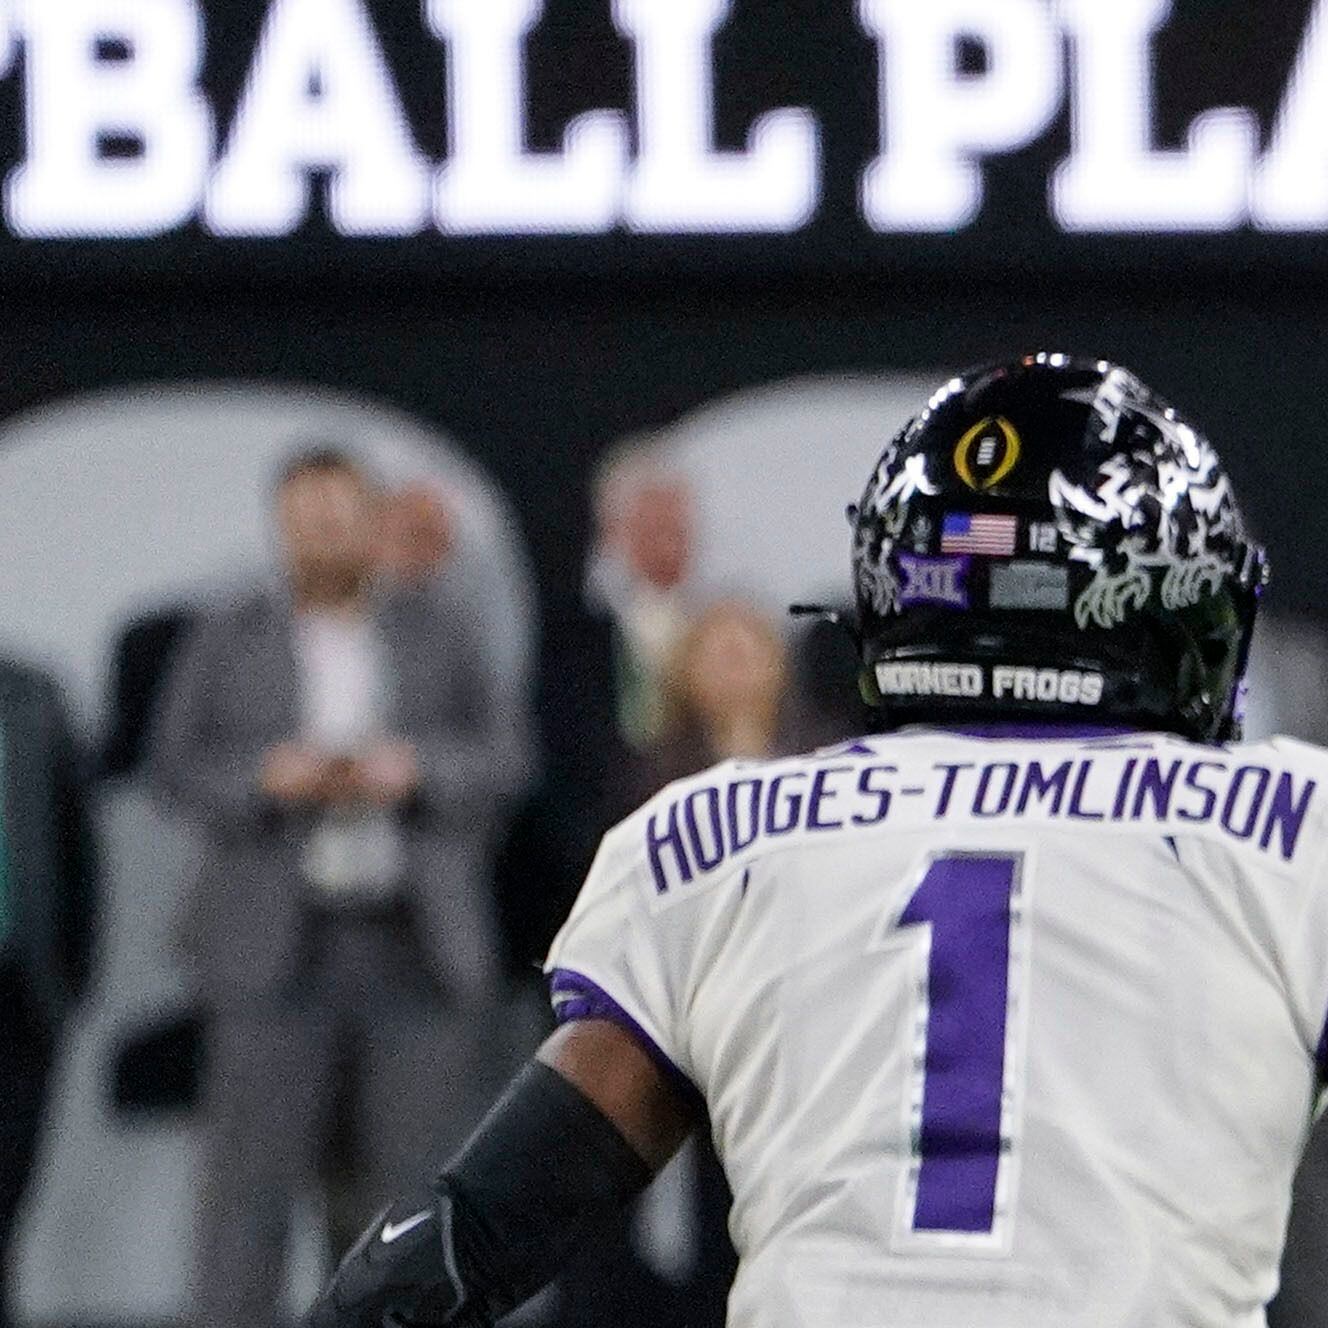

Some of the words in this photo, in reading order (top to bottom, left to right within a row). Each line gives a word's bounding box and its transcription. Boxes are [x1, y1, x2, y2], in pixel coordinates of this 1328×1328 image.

[0, 0, 820, 236] BALL
[992, 664, 1105, 705] FROGS
[645, 757, 1316, 896] HODGES-TOMLINSON
[892, 852, 1022, 1235] 1
